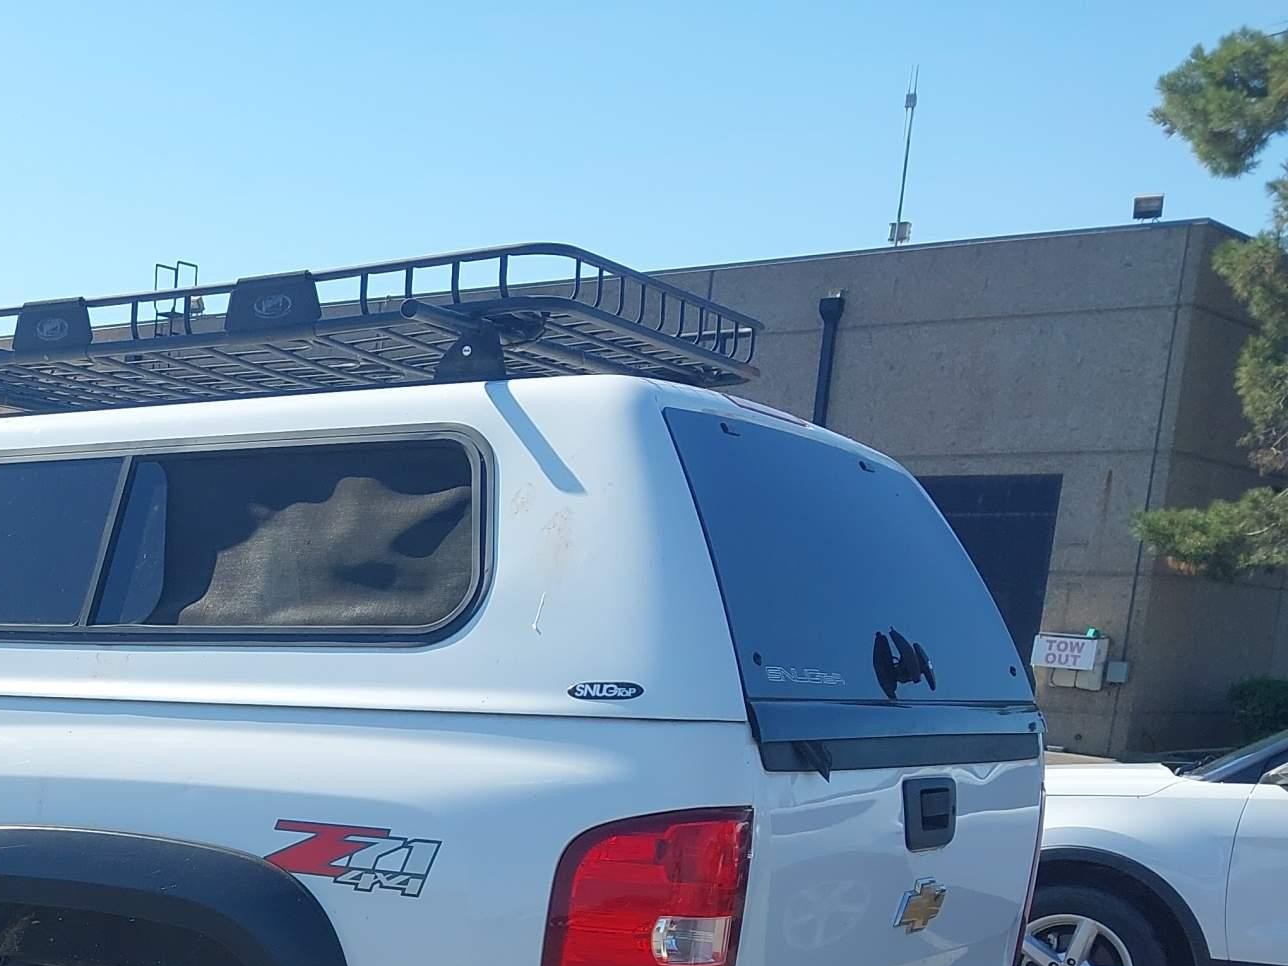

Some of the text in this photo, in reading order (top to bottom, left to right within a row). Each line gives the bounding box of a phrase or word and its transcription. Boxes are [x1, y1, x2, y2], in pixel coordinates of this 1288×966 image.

[1046, 640, 1085, 653] TOW
[1045, 653, 1081, 667] OUT
[263, 819, 442, 880] Z71
